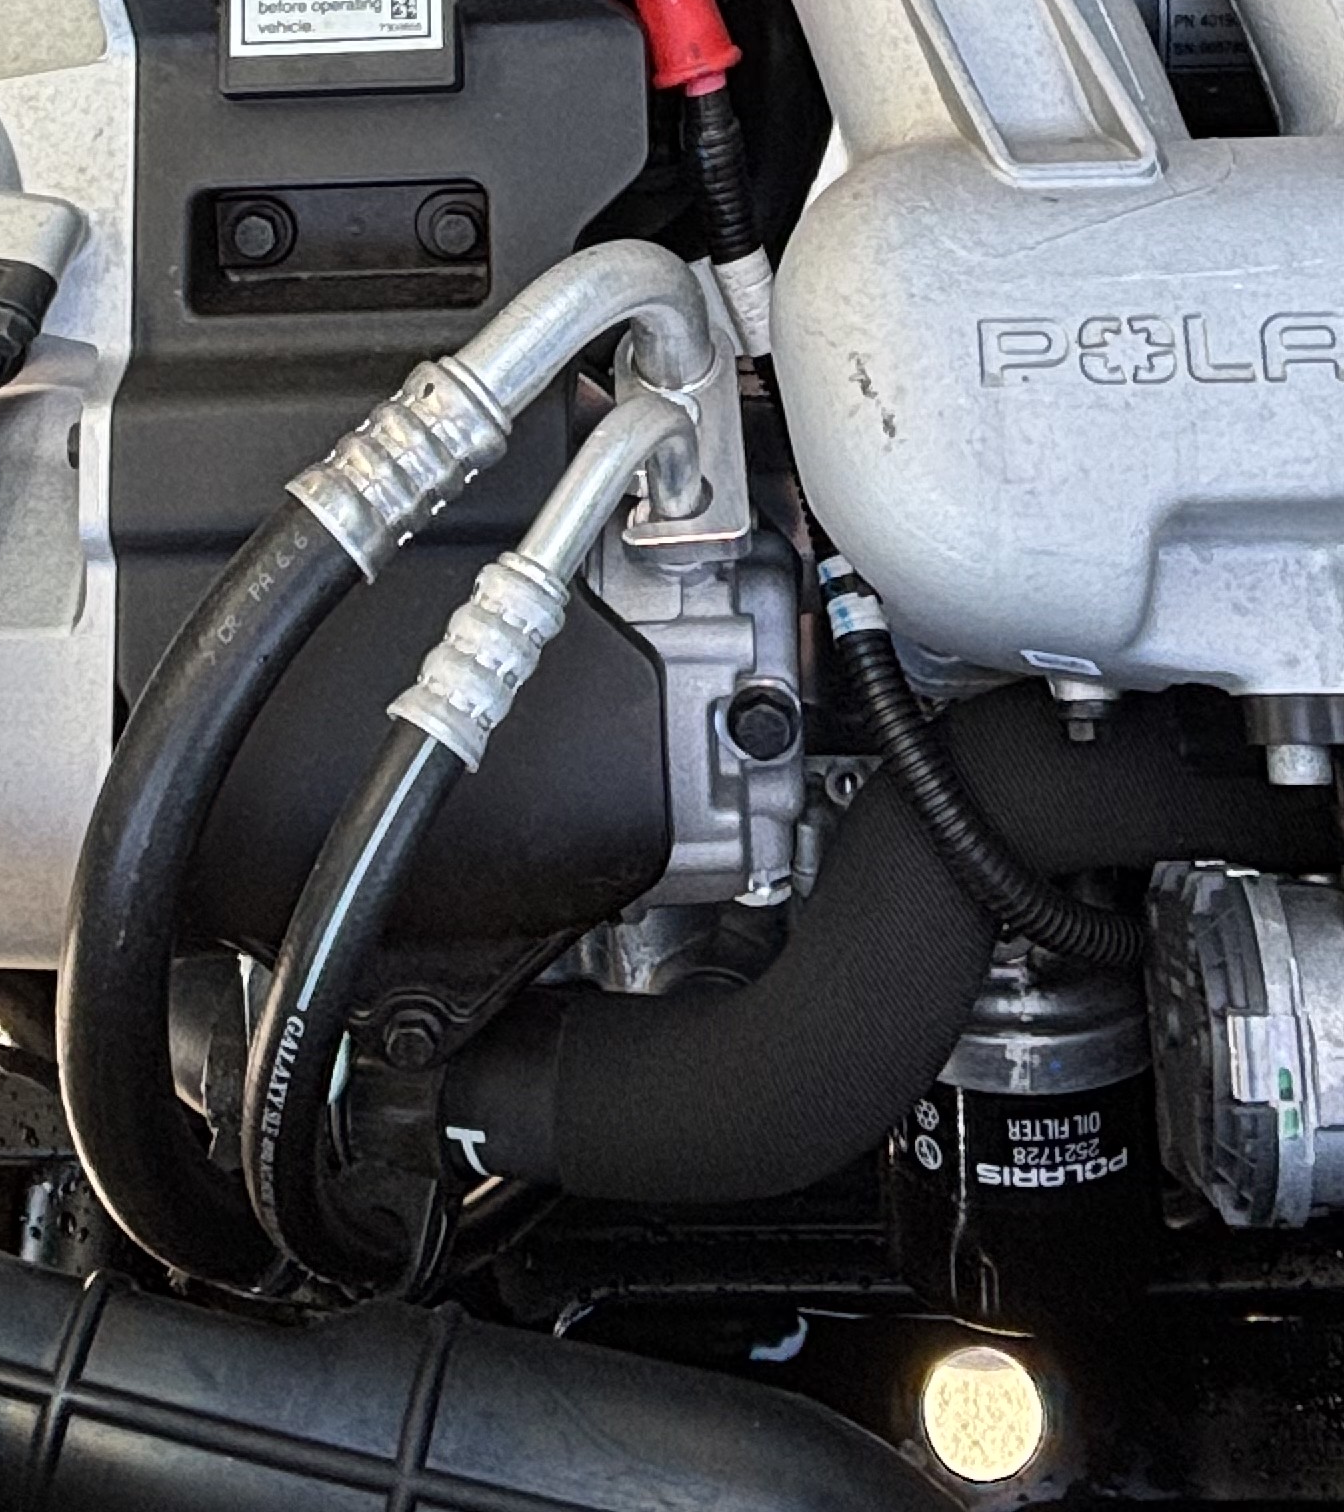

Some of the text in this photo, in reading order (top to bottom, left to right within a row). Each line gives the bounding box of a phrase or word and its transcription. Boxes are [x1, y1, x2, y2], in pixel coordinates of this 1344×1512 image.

[258, 0, 307, 15] before
[257, 20, 316, 34] vehicle.
[248, 572, 275, 602] PA
[267, 1015, 306, 1109] GALAXY
[1007, 1111, 1101, 1141] OIL FILTER
[1013, 1138, 1100, 1165] 2521728
[976, 1147, 1128, 1187] POLARIS
